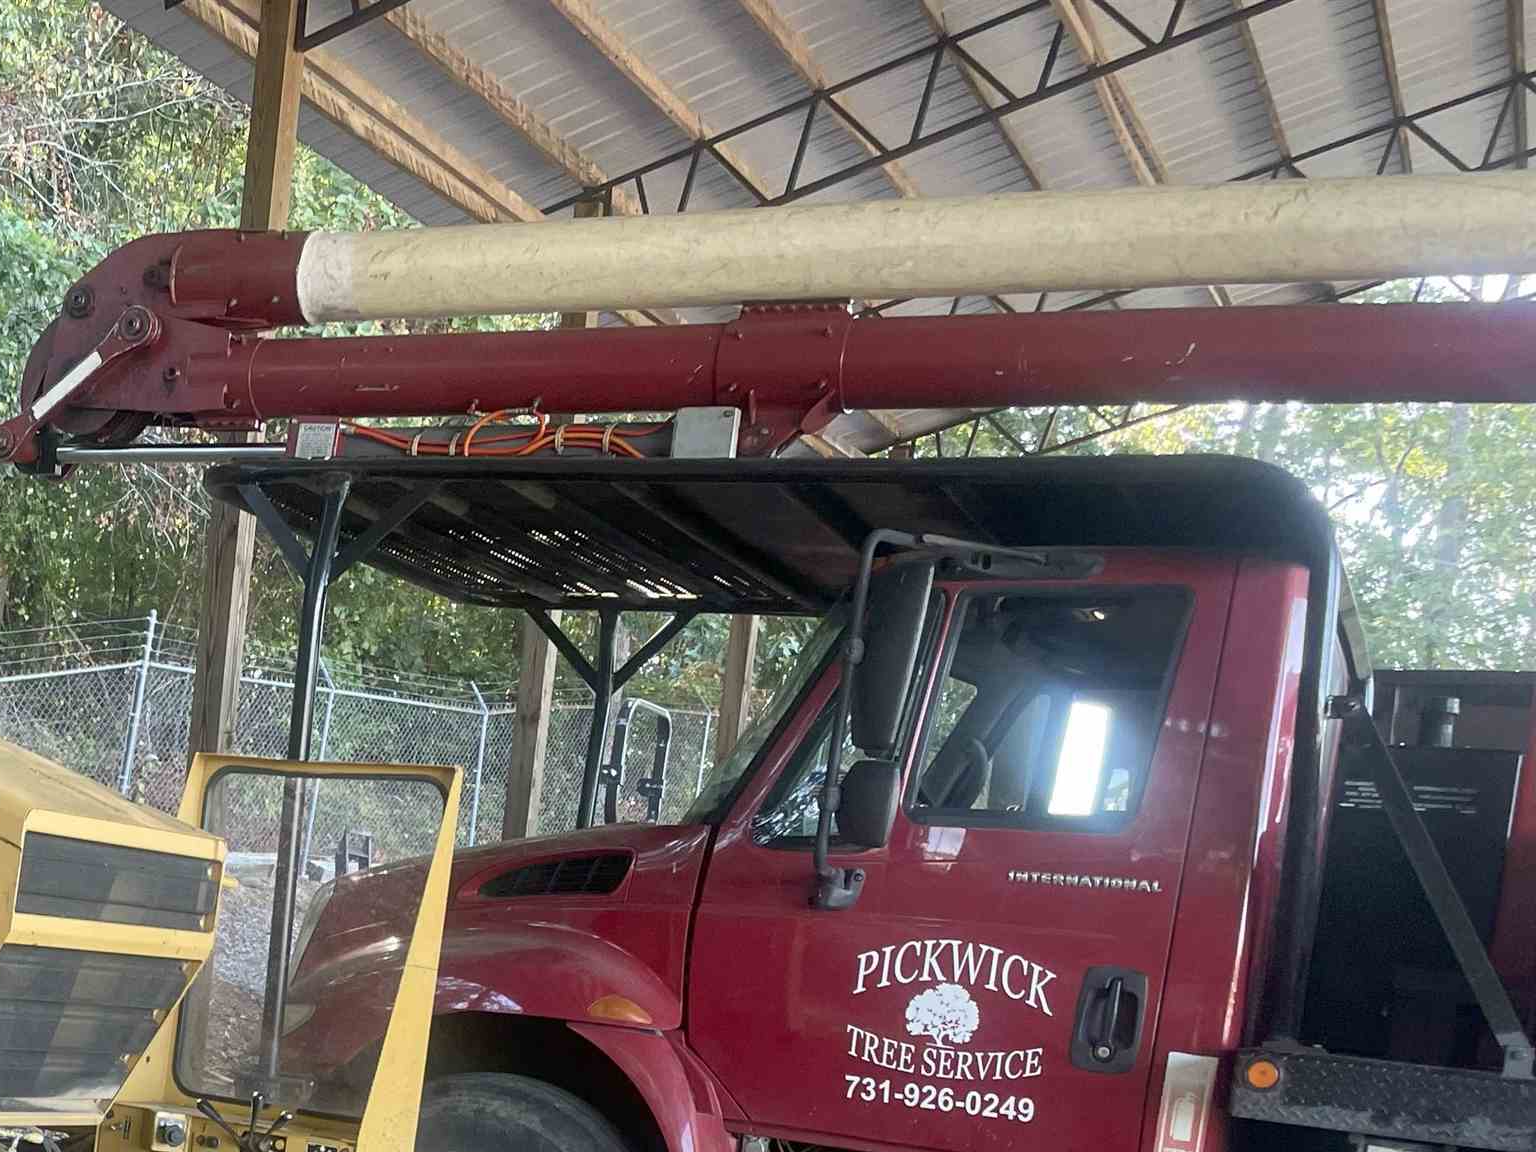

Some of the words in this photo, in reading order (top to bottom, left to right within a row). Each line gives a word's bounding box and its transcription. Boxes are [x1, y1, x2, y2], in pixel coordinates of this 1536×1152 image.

[1007, 869, 1163, 893] INTERNATIONAL
[852, 938, 1057, 1017] PICKWICK
[846, 1023, 915, 1076] TREE
[920, 1047, 1043, 1082] SERVICE
[844, 1074, 1035, 1122] 731-926-0249
